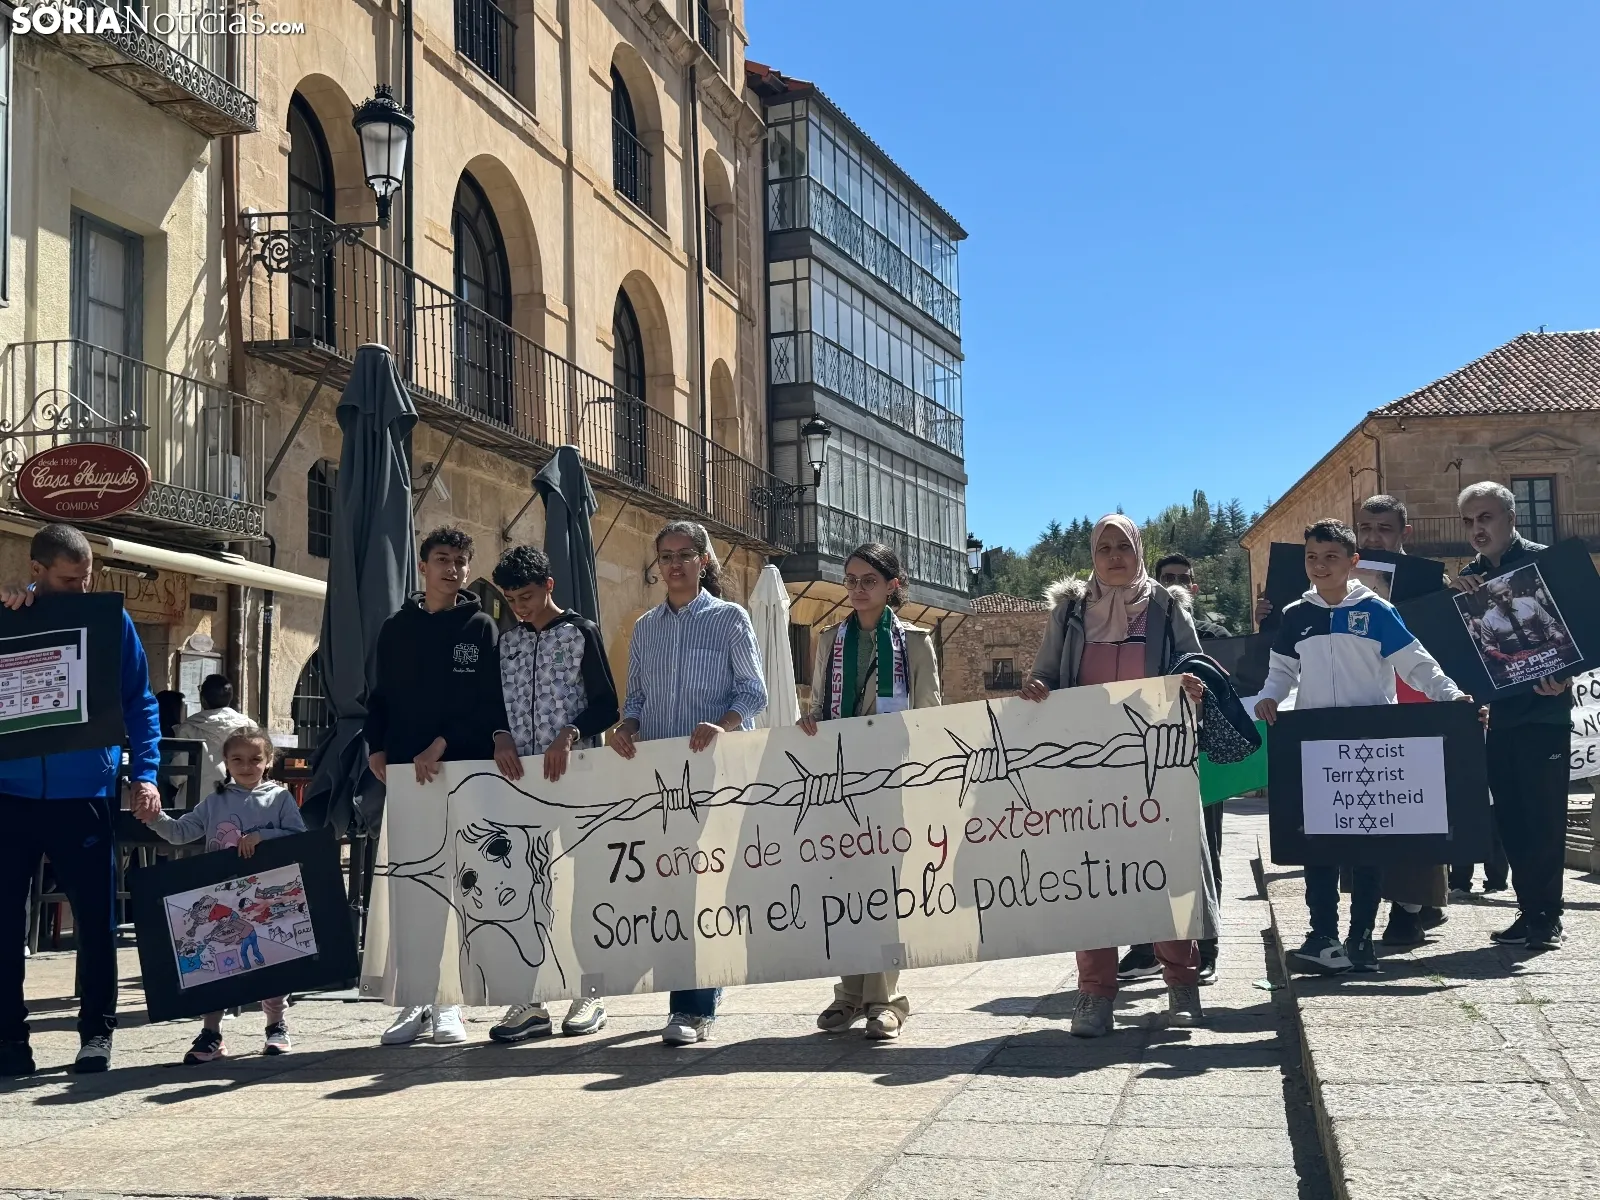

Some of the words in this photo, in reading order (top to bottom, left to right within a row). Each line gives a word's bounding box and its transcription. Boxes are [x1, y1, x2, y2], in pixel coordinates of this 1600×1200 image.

[31, 466, 70, 488] Casa
[74, 460, 139, 498] Augusto
[38, 457, 59, 466] desde
[60, 458, 78, 466] 1939
[56, 501, 99, 511] COMIDAS
[607, 840, 646, 883] 75
[656, 846, 726, 878] años
[744, 824, 782, 869] de
[800, 815, 912, 863] asedio
[928, 824, 948, 873] y
[965, 795, 1170, 844] exterminio.
[592, 902, 688, 949] Soria
[697, 903, 753, 939] con
[767, 883, 807, 931] el
[822, 861, 957, 960] pueblo
[973, 848, 1167, 943] palestino
